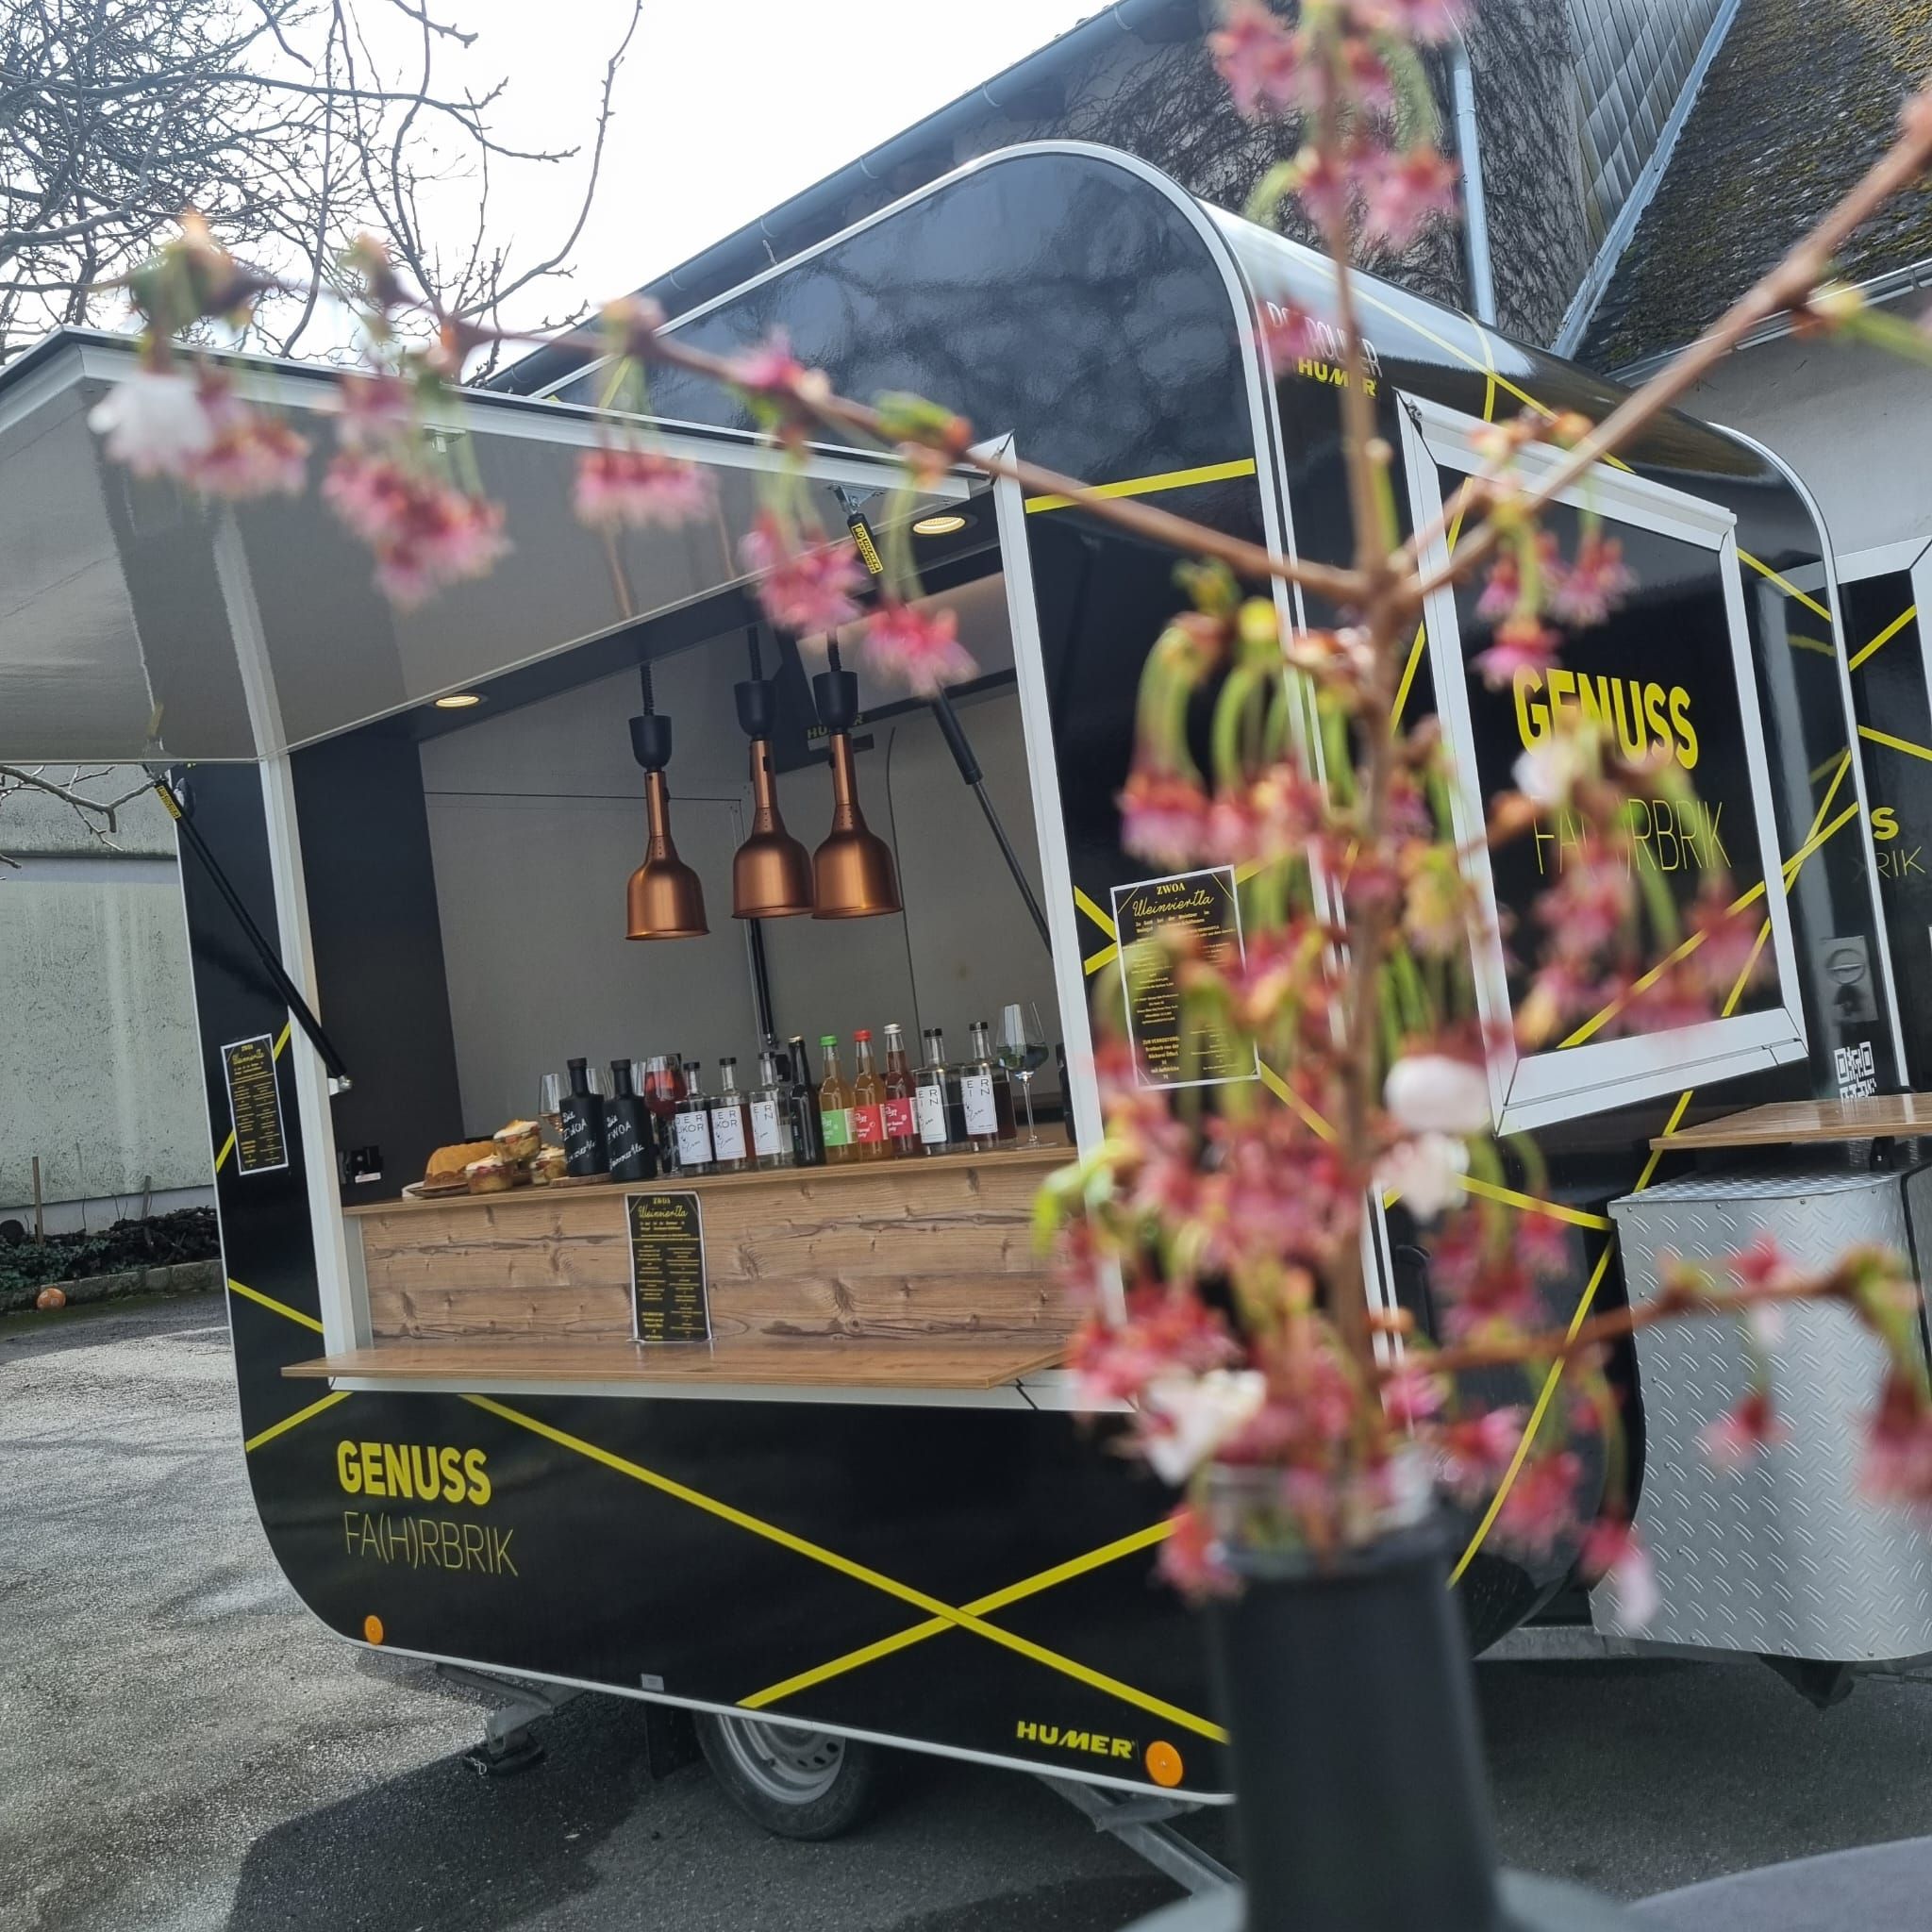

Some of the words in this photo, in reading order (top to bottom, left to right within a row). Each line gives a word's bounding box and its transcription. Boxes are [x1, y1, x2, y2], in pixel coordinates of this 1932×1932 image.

[1297, 357, 1377, 397] HUMR
[807, 714, 863, 740] HUR
[1157, 882, 1186, 895] ZWOA
[337, 1440, 491, 1506] GENUSS
[344, 1510, 518, 1577] FA(H)RBRIK
[1017, 1720, 1133, 1758] HUMER
